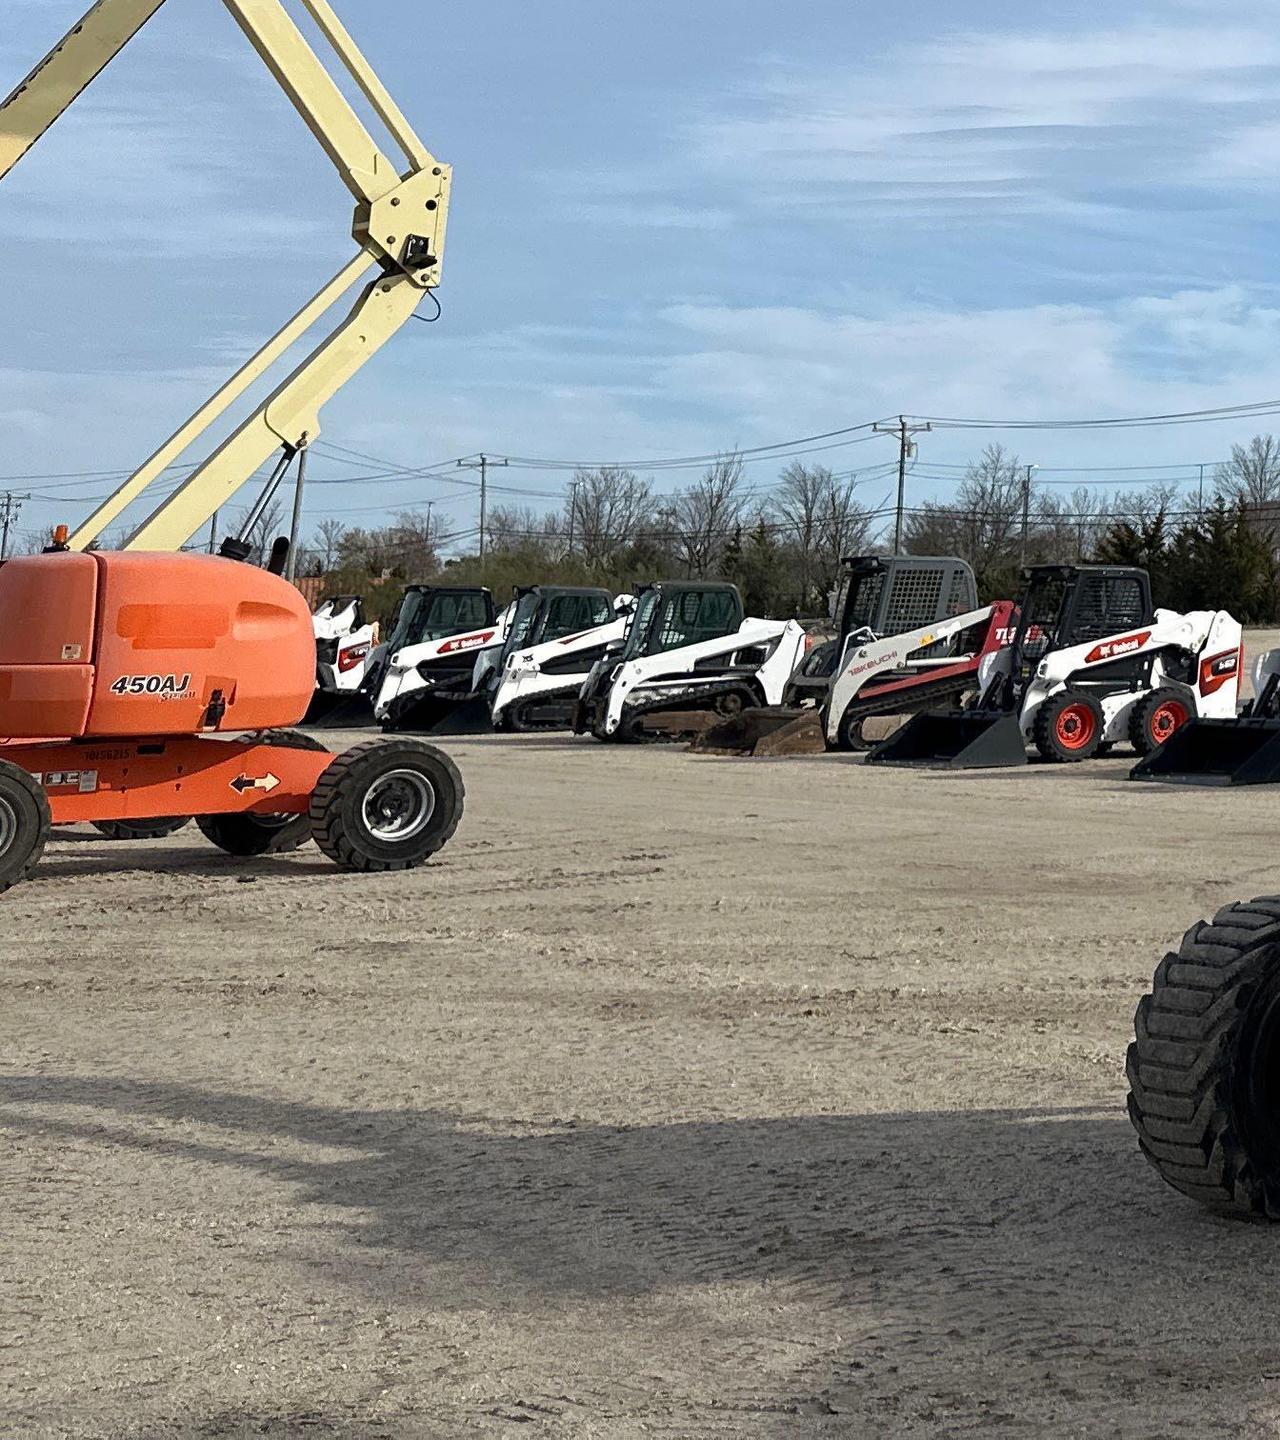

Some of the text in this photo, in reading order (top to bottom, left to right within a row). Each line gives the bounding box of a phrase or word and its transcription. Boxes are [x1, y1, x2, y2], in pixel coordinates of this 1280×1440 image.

[1112, 638, 1139, 655] Bobcat
[848, 650, 898, 677] TAKEUCHI
[110, 673, 192, 696] 450AJ
